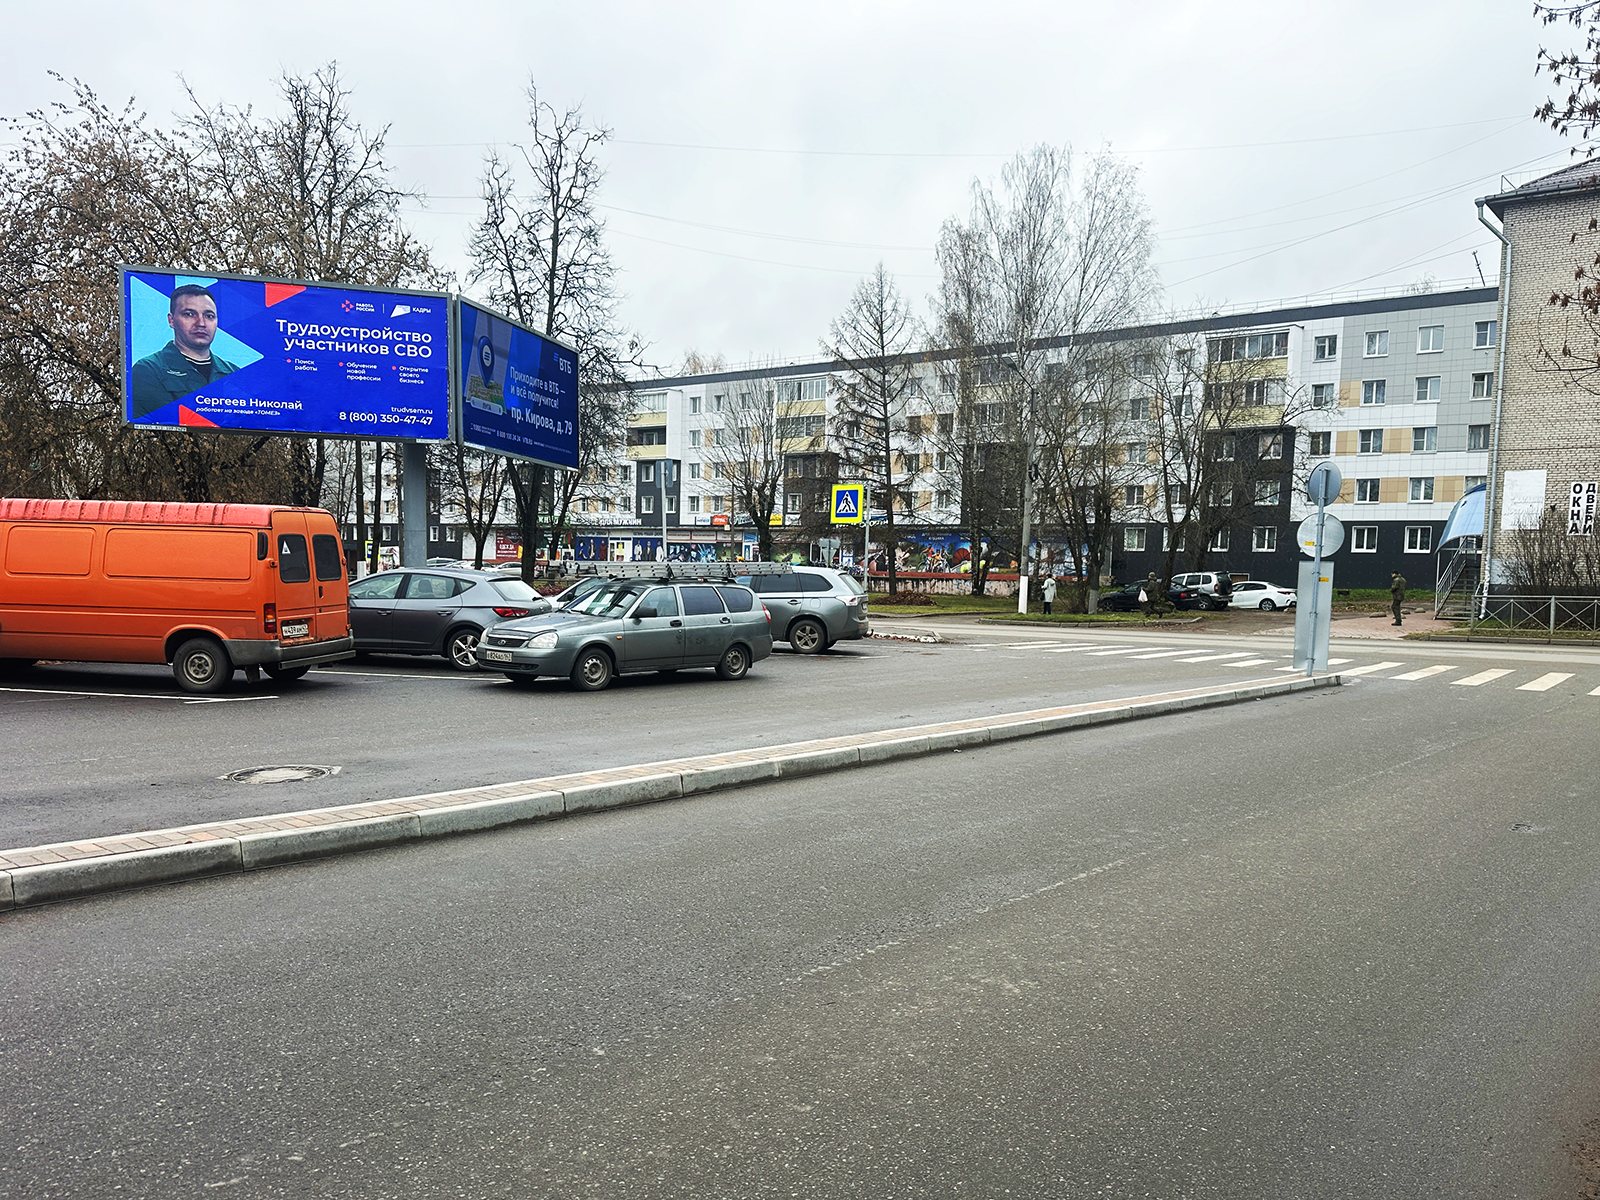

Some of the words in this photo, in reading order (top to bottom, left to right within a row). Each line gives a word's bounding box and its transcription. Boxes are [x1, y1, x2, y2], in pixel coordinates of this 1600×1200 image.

[276, 319, 432, 343] Трудоустройство
[284, 337, 389, 355] участников
[394, 344, 432, 358] СВО
[559, 358, 572, 374] ВТБ
[510, 366, 543, 389] Приходите
[549, 380, 559, 394] ВТБ
[195, 395, 247, 406] Сергеев
[250, 398, 302, 410] Николай
[528, 391, 559, 409] получится!
[339, 412, 346, 420] 8
[349, 412, 378, 424] (800)
[380, 414, 433, 425] 350-47-47
[511, 407, 524, 423] пр.
[525, 408, 555, 432] Кирова,
[557, 421, 564, 434] д.
[565, 421, 572, 435] 79
[1569, 483, 1583, 534] ОКНА
[1583, 483, 1596, 534] ДВЕРИ
